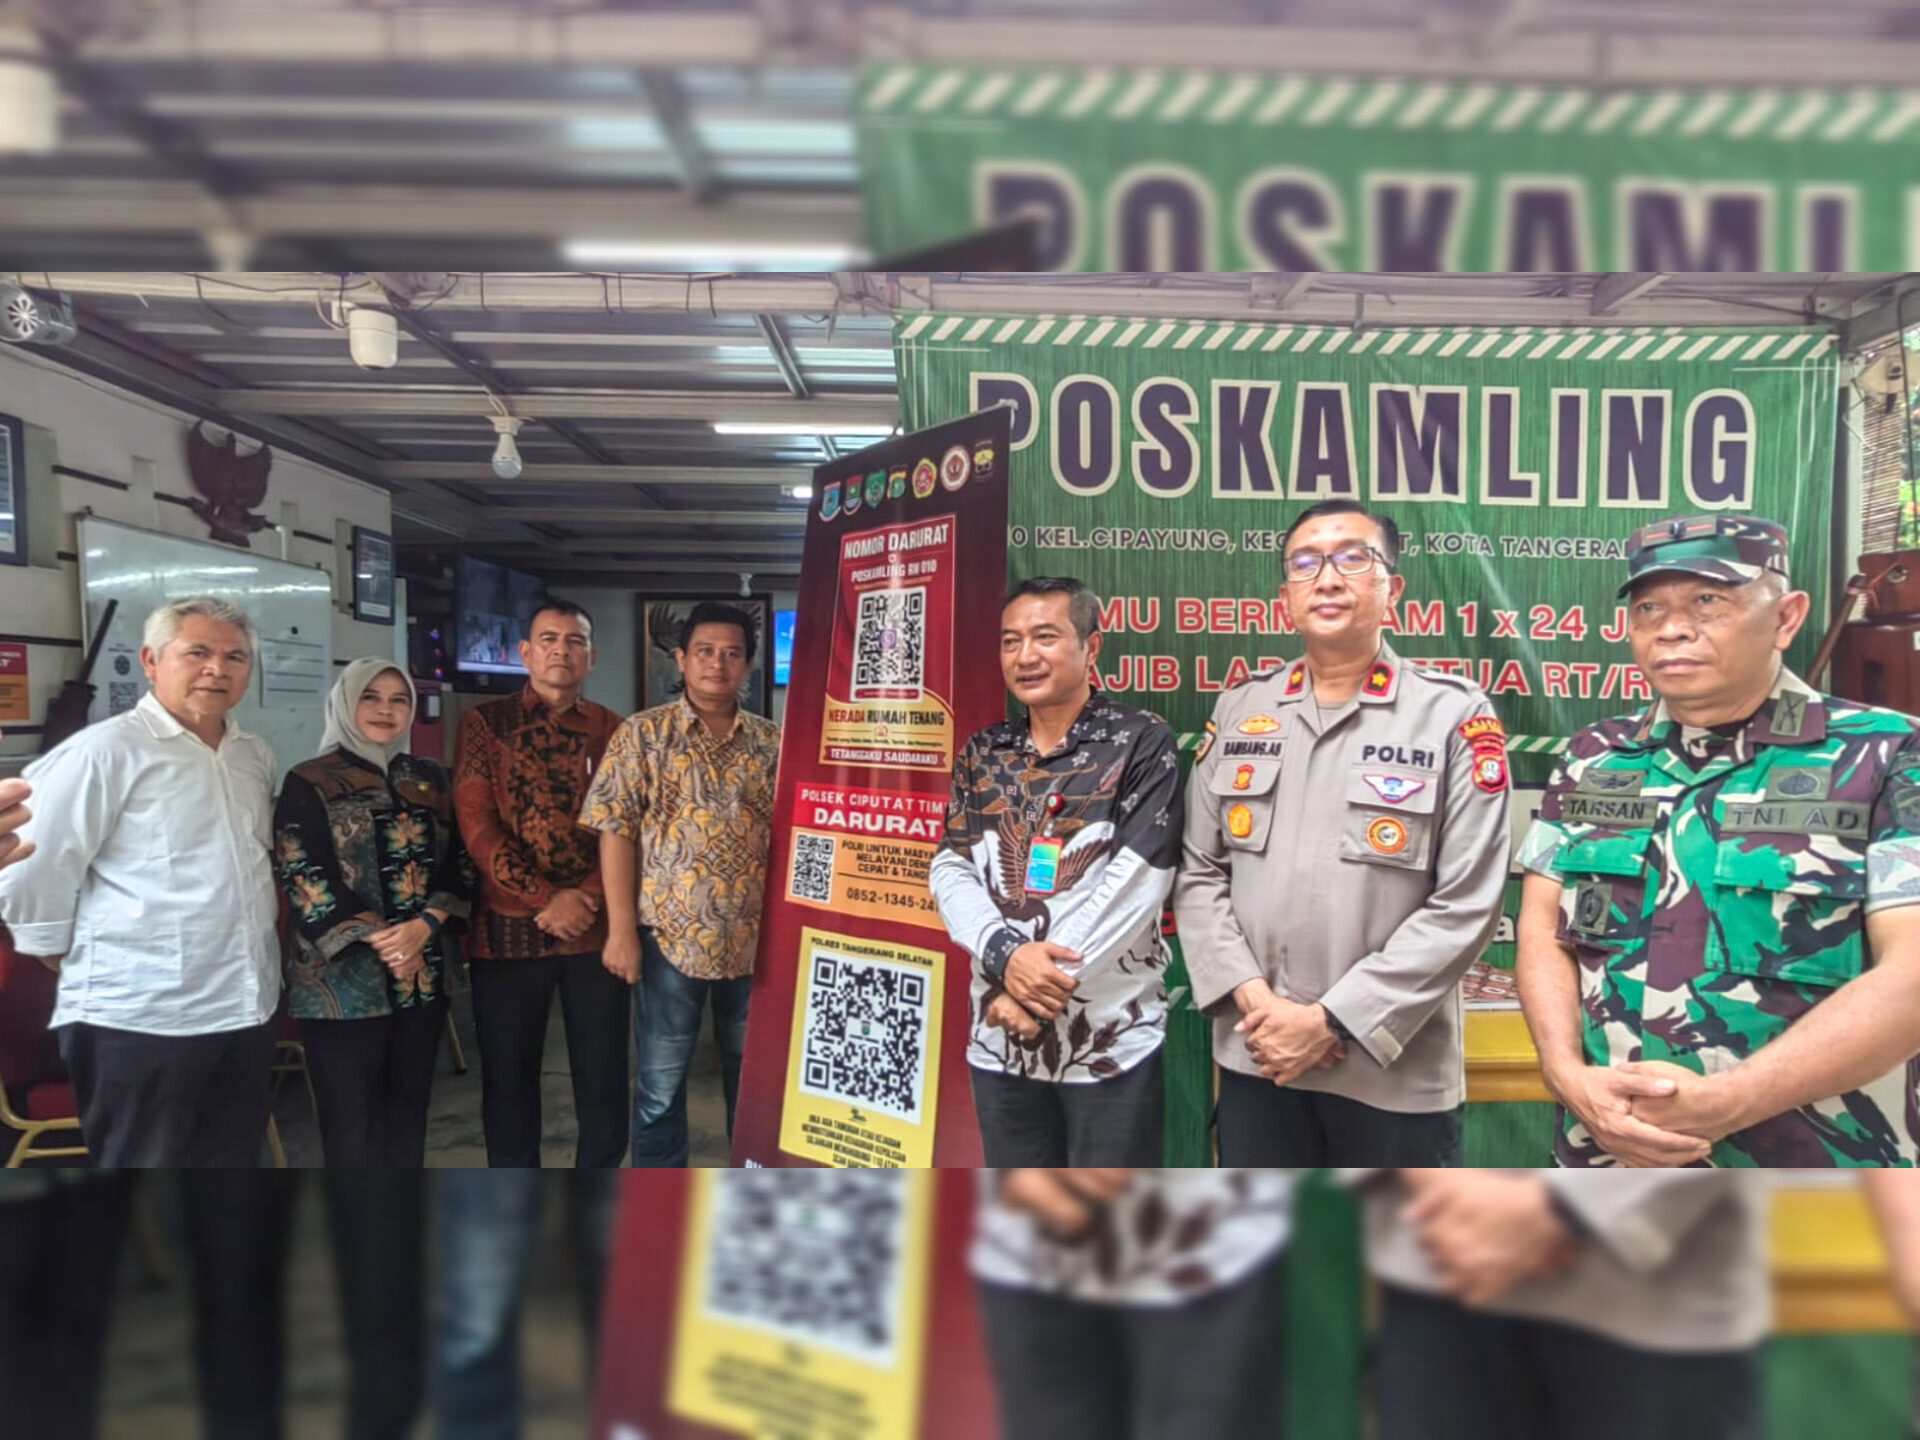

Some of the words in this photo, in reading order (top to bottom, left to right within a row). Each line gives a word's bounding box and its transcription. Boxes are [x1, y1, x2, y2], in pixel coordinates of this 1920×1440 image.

[969, 372, 1757, 510] POSKAMLING
[844, 534, 885, 560] NOMOR
[887, 523, 949, 552] DARURAT
[1035, 525, 1236, 554] KEL.CIPAYUNG,
[1424, 532, 1495, 557] KOTA
[1456, 602, 1478, 637] 1
[1529, 604, 1588, 641] 24
[1362, 745, 1435, 768] POLRI
[801, 788, 846, 806] POLSEK
[849, 793, 915, 812] CIPUTAT
[918, 799, 946, 815] TIM
[1568, 799, 1645, 821] TARSAN
[814, 807, 942, 838] DARURAT
[1733, 809, 1788, 826] TNI
[1803, 812, 1860, 831] AD
[857, 853, 908, 868] MELAYANI
[866, 843, 902, 857] UNTUK
[858, 863, 890, 877] CEPAT
[847, 887, 940, 911] 0852-1345-24
